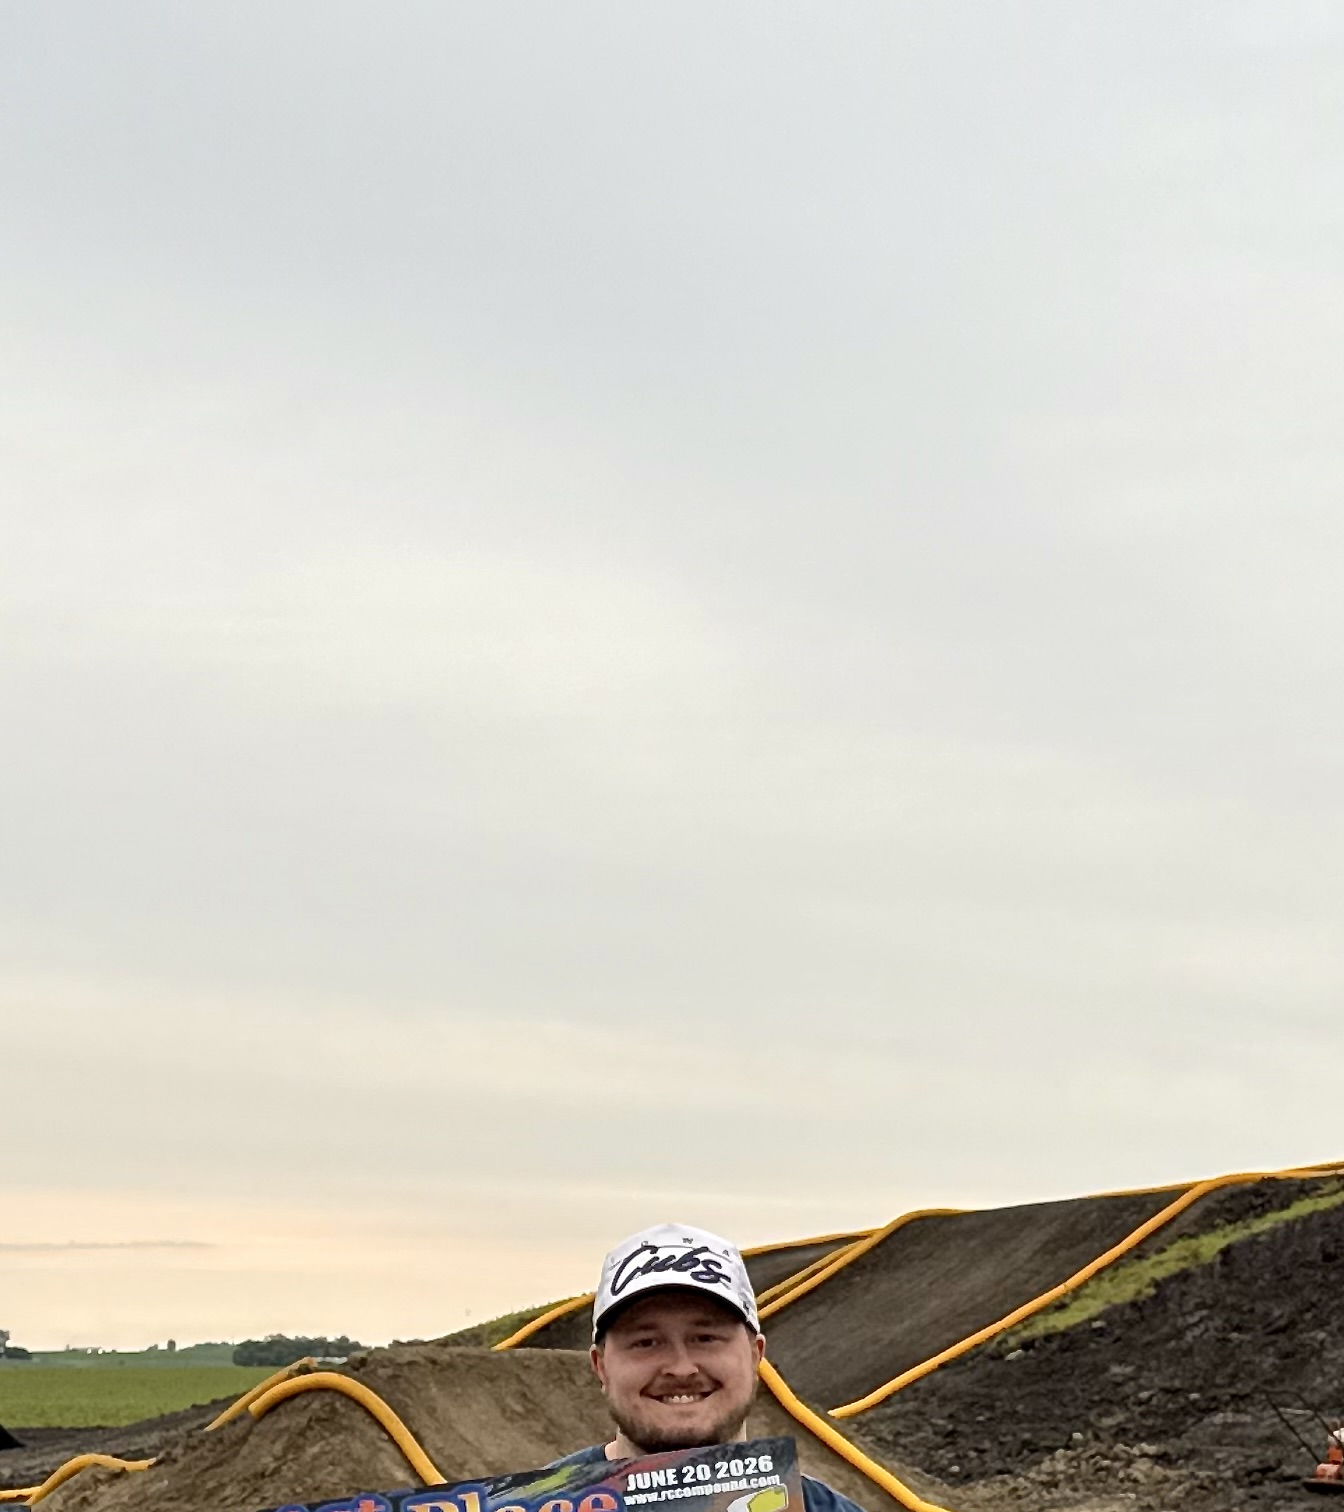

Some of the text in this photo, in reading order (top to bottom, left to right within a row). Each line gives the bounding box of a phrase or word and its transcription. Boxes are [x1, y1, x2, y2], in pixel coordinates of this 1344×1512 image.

[610, 1245, 732, 1297] Cubs
[623, 1474, 780, 1506] www.rccompound.com
[626, 1455, 774, 1492] JUNE 20 2026
